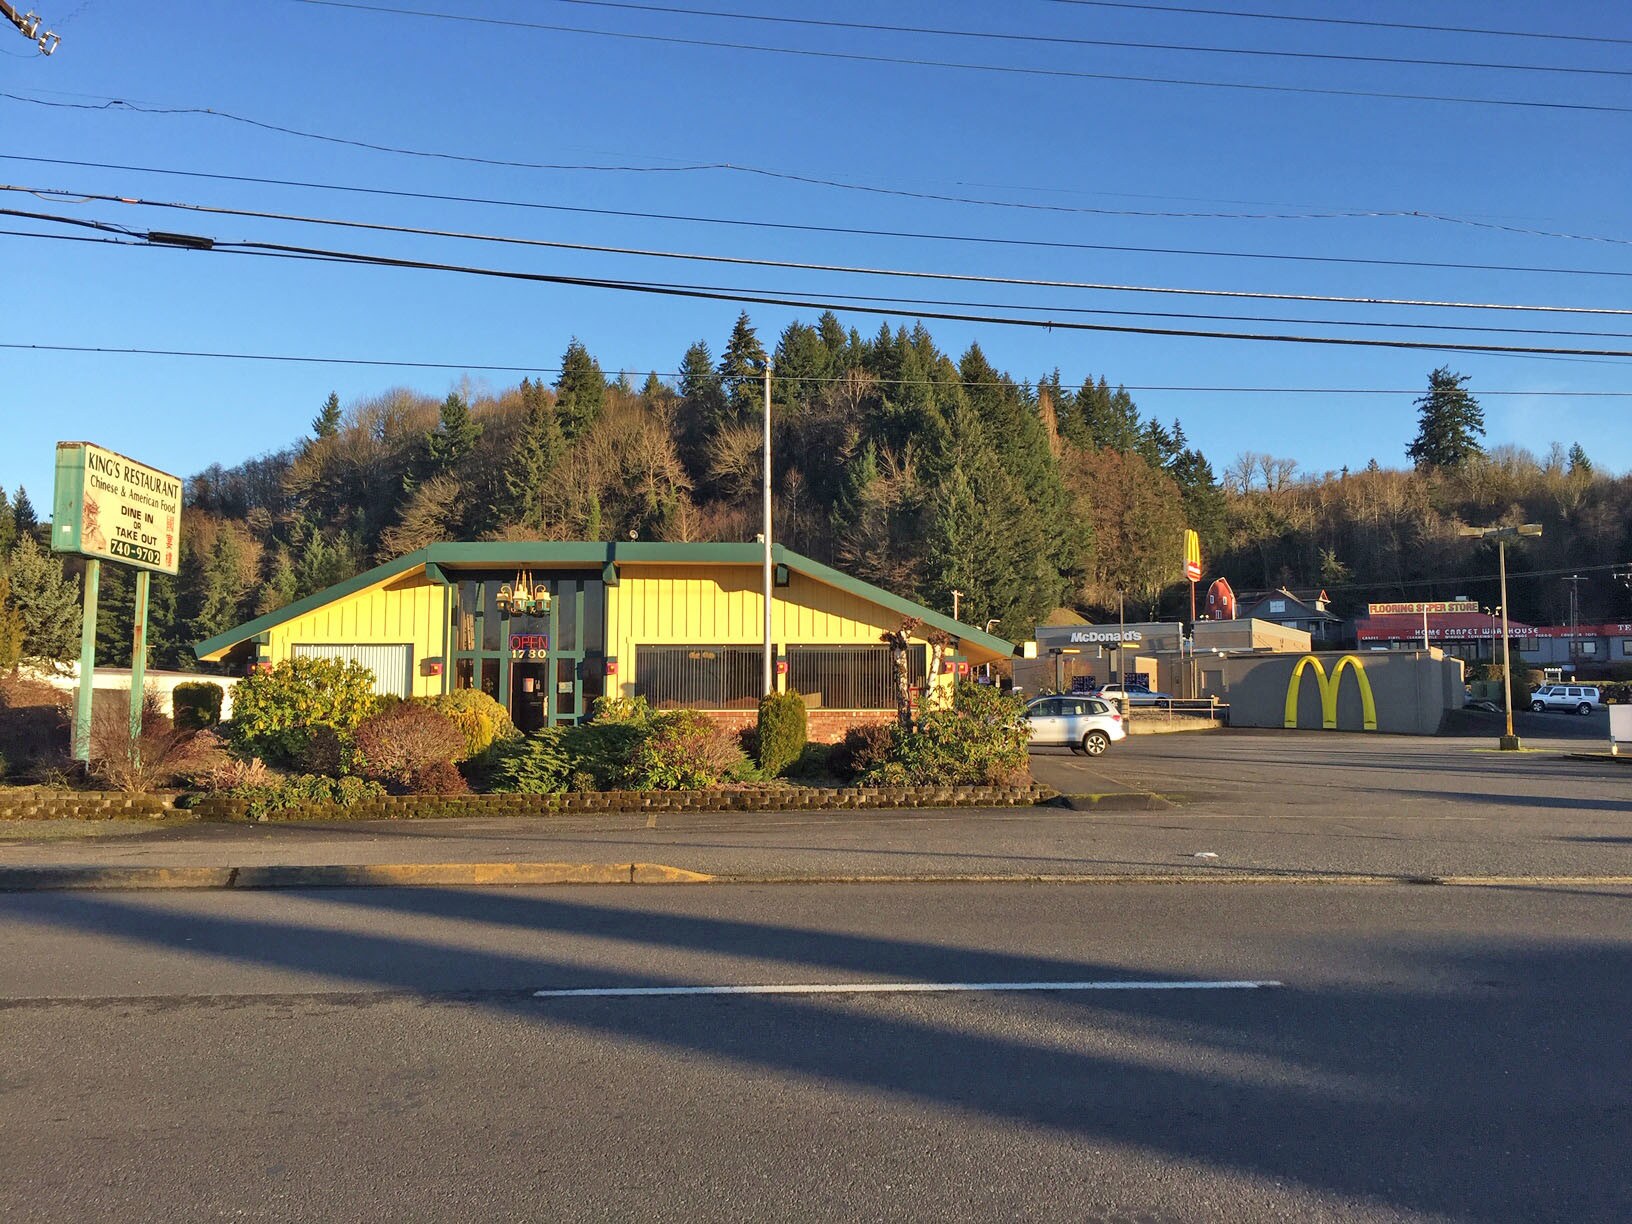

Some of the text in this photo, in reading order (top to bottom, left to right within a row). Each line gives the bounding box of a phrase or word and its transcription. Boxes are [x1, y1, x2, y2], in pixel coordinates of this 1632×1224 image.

[88, 452, 179, 500] KING'S RESTAURANT
[90, 474, 176, 515] Chinese & American Food
[121, 505, 154, 524] DINE IN
[133, 520, 142, 531] OR
[115, 525, 158, 546] TAKE OUT
[111, 540, 160, 564] 740-9702
[1370, 604, 1414, 613] FLOORING
[1448, 602, 1478, 611] STORE
[1444, 628, 1479, 636] CARPET
[1481, 627, 1539, 635] WARHOUSE
[511, 635, 548, 649] OPEN
